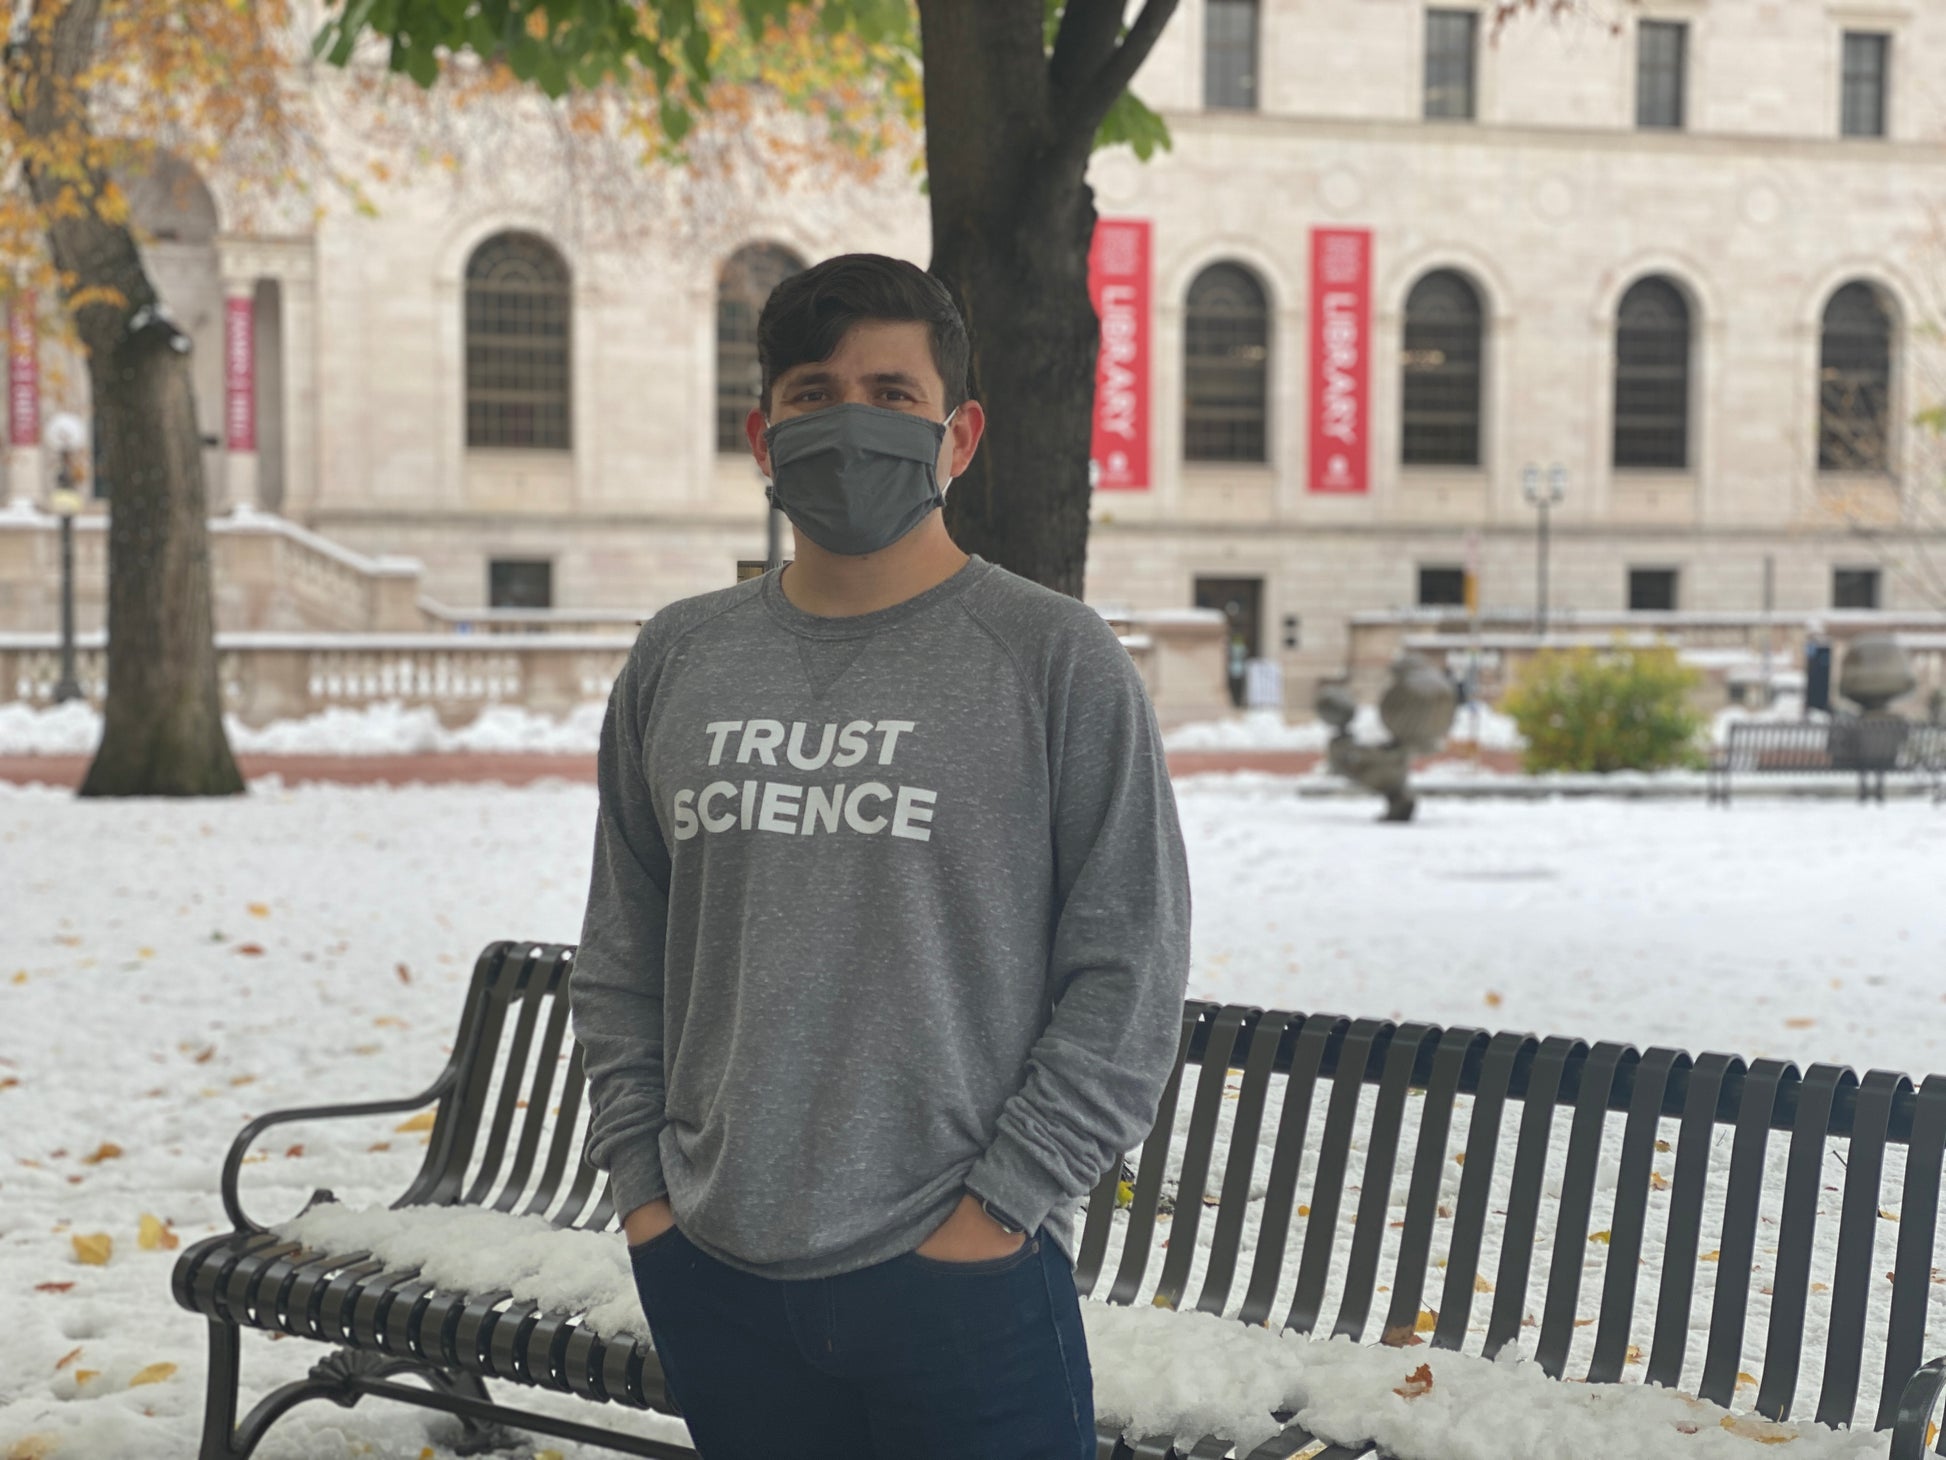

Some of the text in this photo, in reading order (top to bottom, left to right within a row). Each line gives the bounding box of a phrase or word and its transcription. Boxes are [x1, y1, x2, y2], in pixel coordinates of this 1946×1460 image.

[1101, 285, 1137, 440] LIBRARY
[1322, 291, 1359, 445] LIBRARY
[705, 719, 915, 771] TRUST
[673, 780, 938, 841] SCIENCE
